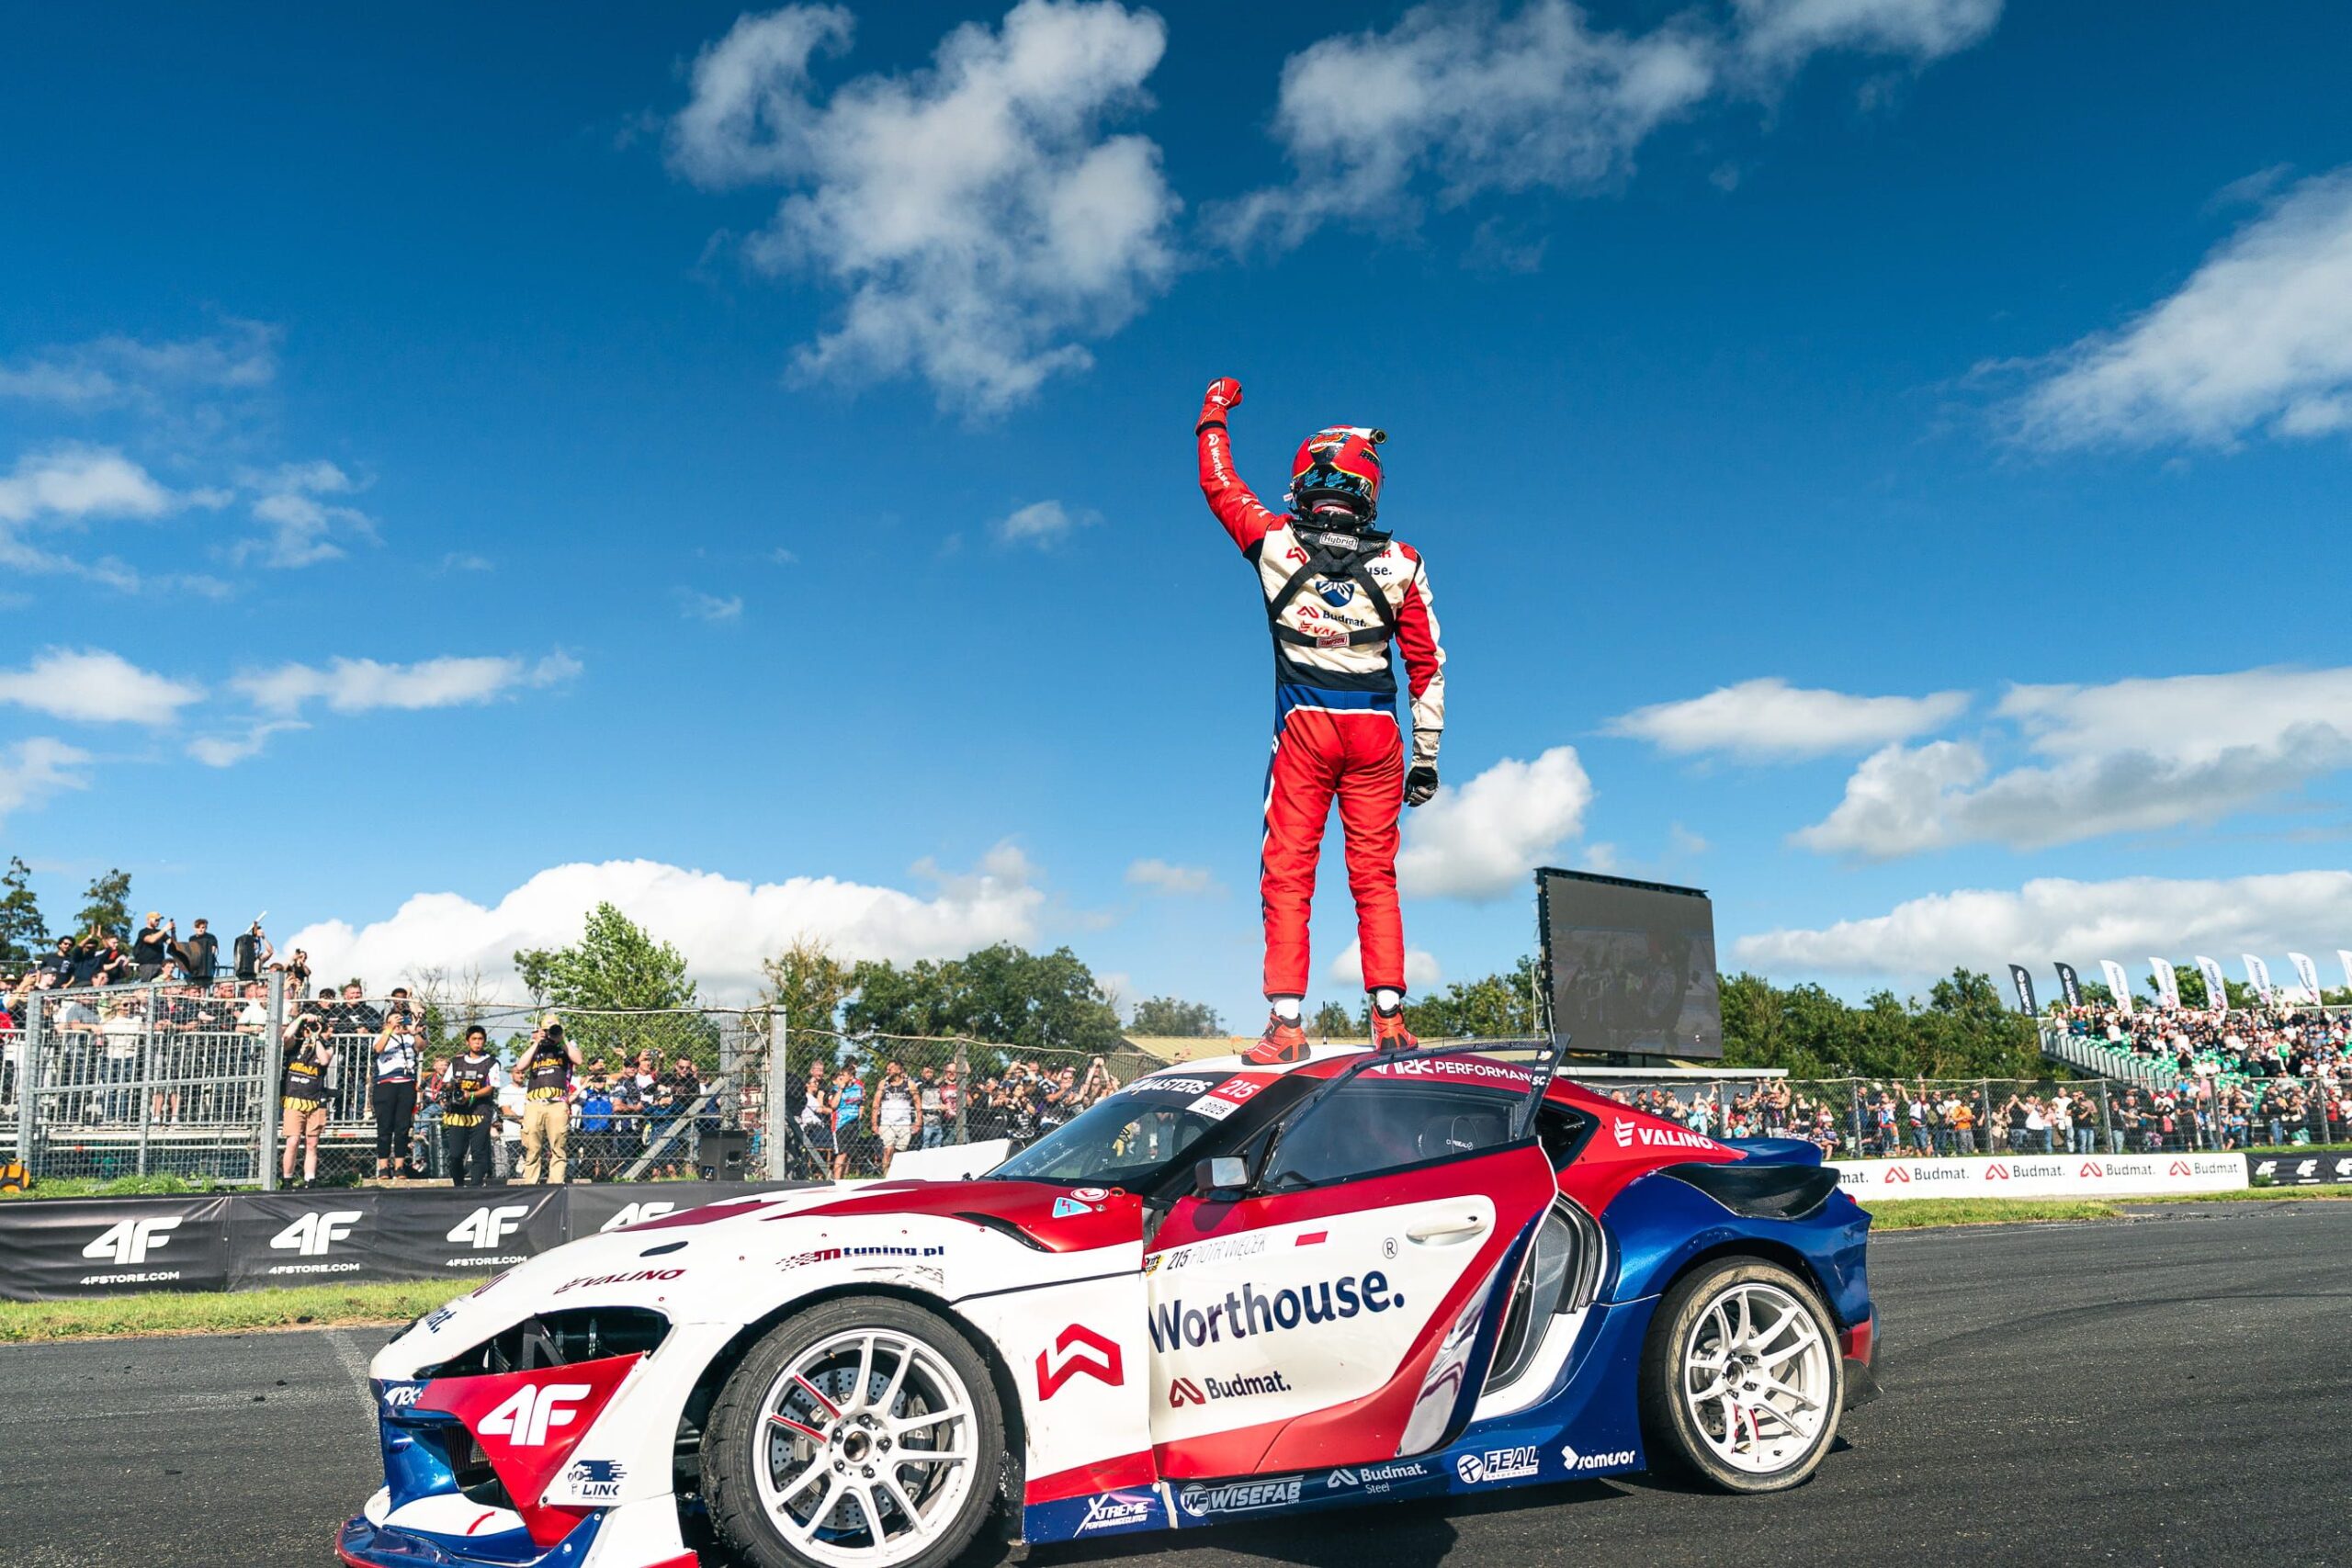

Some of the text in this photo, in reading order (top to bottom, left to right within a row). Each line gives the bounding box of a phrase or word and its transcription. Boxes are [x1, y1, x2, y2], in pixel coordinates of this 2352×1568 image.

[1323, 535, 1355, 547] Hybrid
[1216, 1079, 1261, 1099] 215
[1199, 1102, 1228, 1115] 2025
[1915, 1167, 1970, 1180] Budmat.
[2013, 1165, 2066, 1178] Budmat.
[2106, 1163, 2156, 1176] Budmat.
[2296, 1159, 2317, 1177] 4F
[270, 1211, 364, 1256] 4F
[446, 1205, 530, 1249] 4F
[82, 1216, 184, 1265] 4F
[446, 1256, 527, 1268] 4FSTORE.COM
[1167, 1248, 1193, 1270] 215
[80, 1271, 180, 1286] 4FSTORE.COM
[268, 1263, 360, 1275] 4FSTORE.COM
[582, 1269, 687, 1288] VALINO
[1148, 1269, 1405, 1353] Worthouse.
[1206, 1371, 1292, 1400] Budmat.
[477, 1383, 593, 1446] 4F
[1484, 1446, 1540, 1472] FEAL
[1361, 1462, 1428, 1483] Budmat.
[1210, 1482, 1302, 1509] WISEFAB
[1366, 1482, 1390, 1494] Steel
